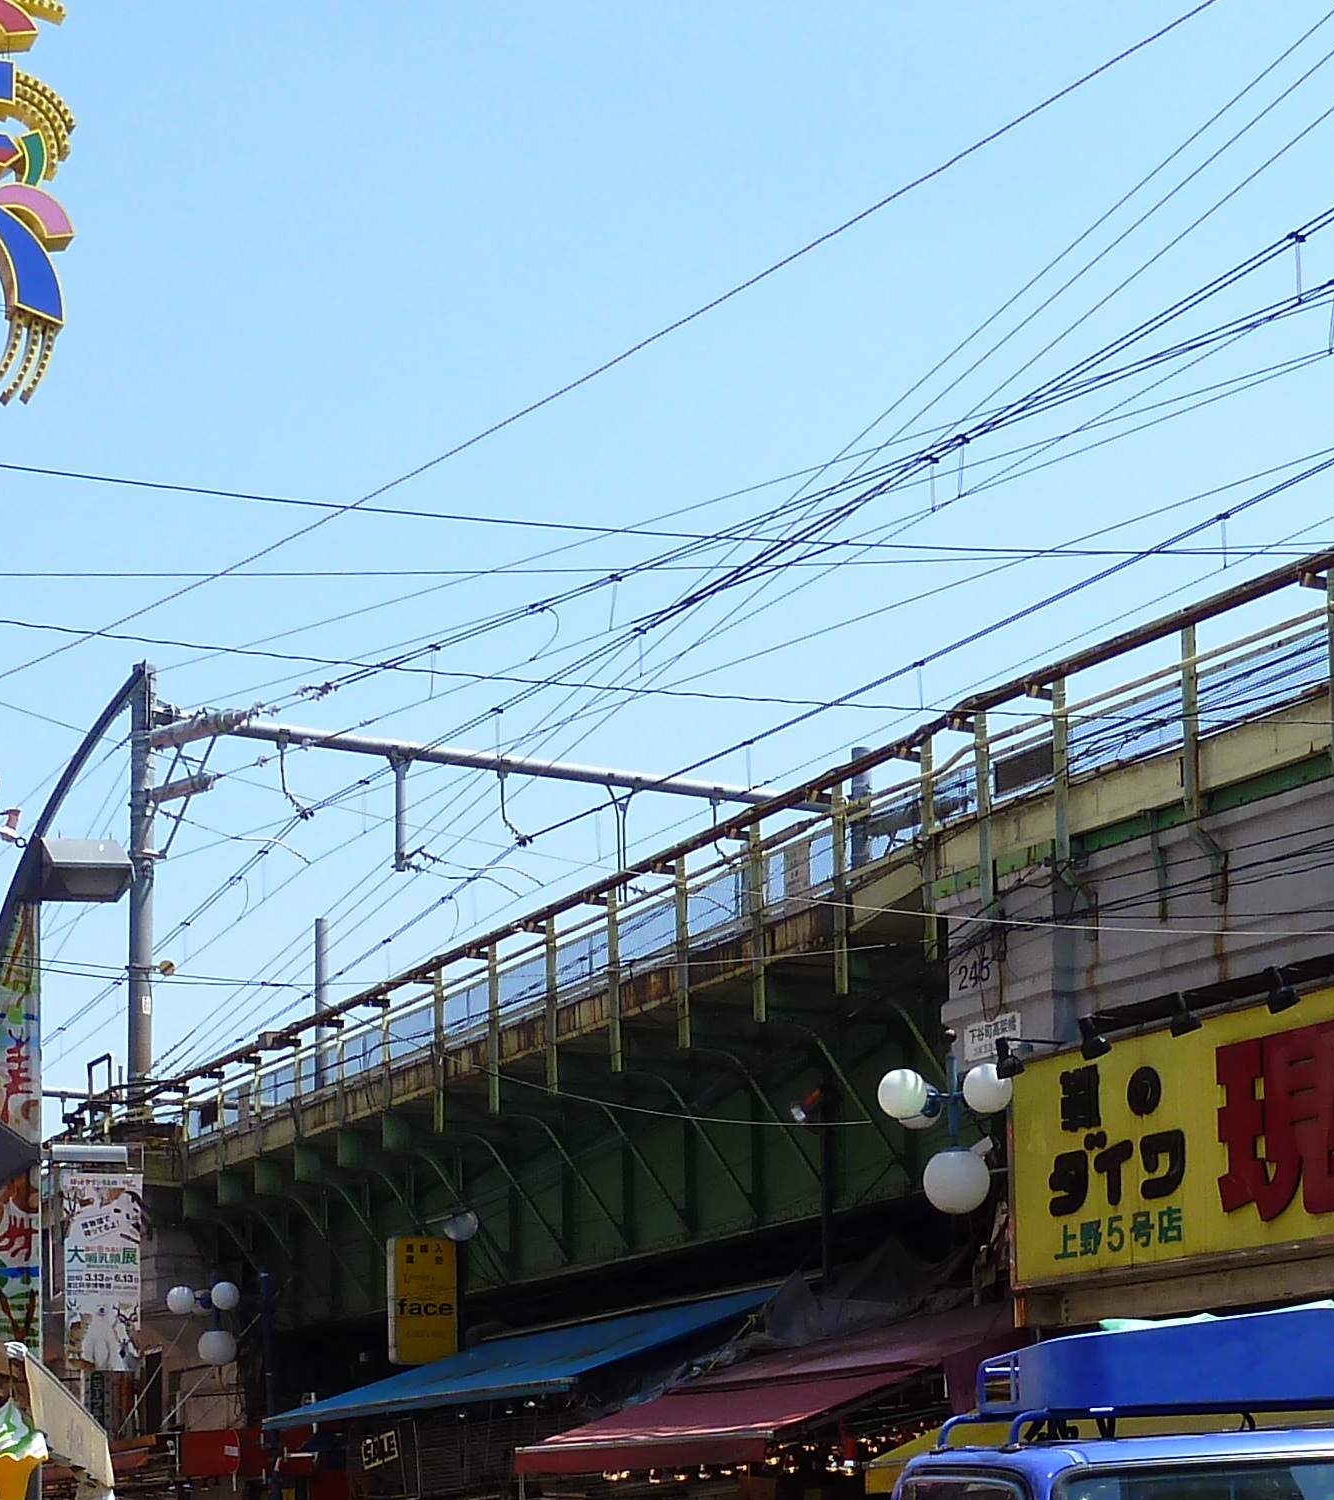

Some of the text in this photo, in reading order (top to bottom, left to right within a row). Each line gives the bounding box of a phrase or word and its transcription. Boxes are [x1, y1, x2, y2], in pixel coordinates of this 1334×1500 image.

[1049, 1129, 1186, 1217] ダイワ
[1055, 1206, 1183, 1260] 上野5号店
[398, 1298, 454, 1316] face
